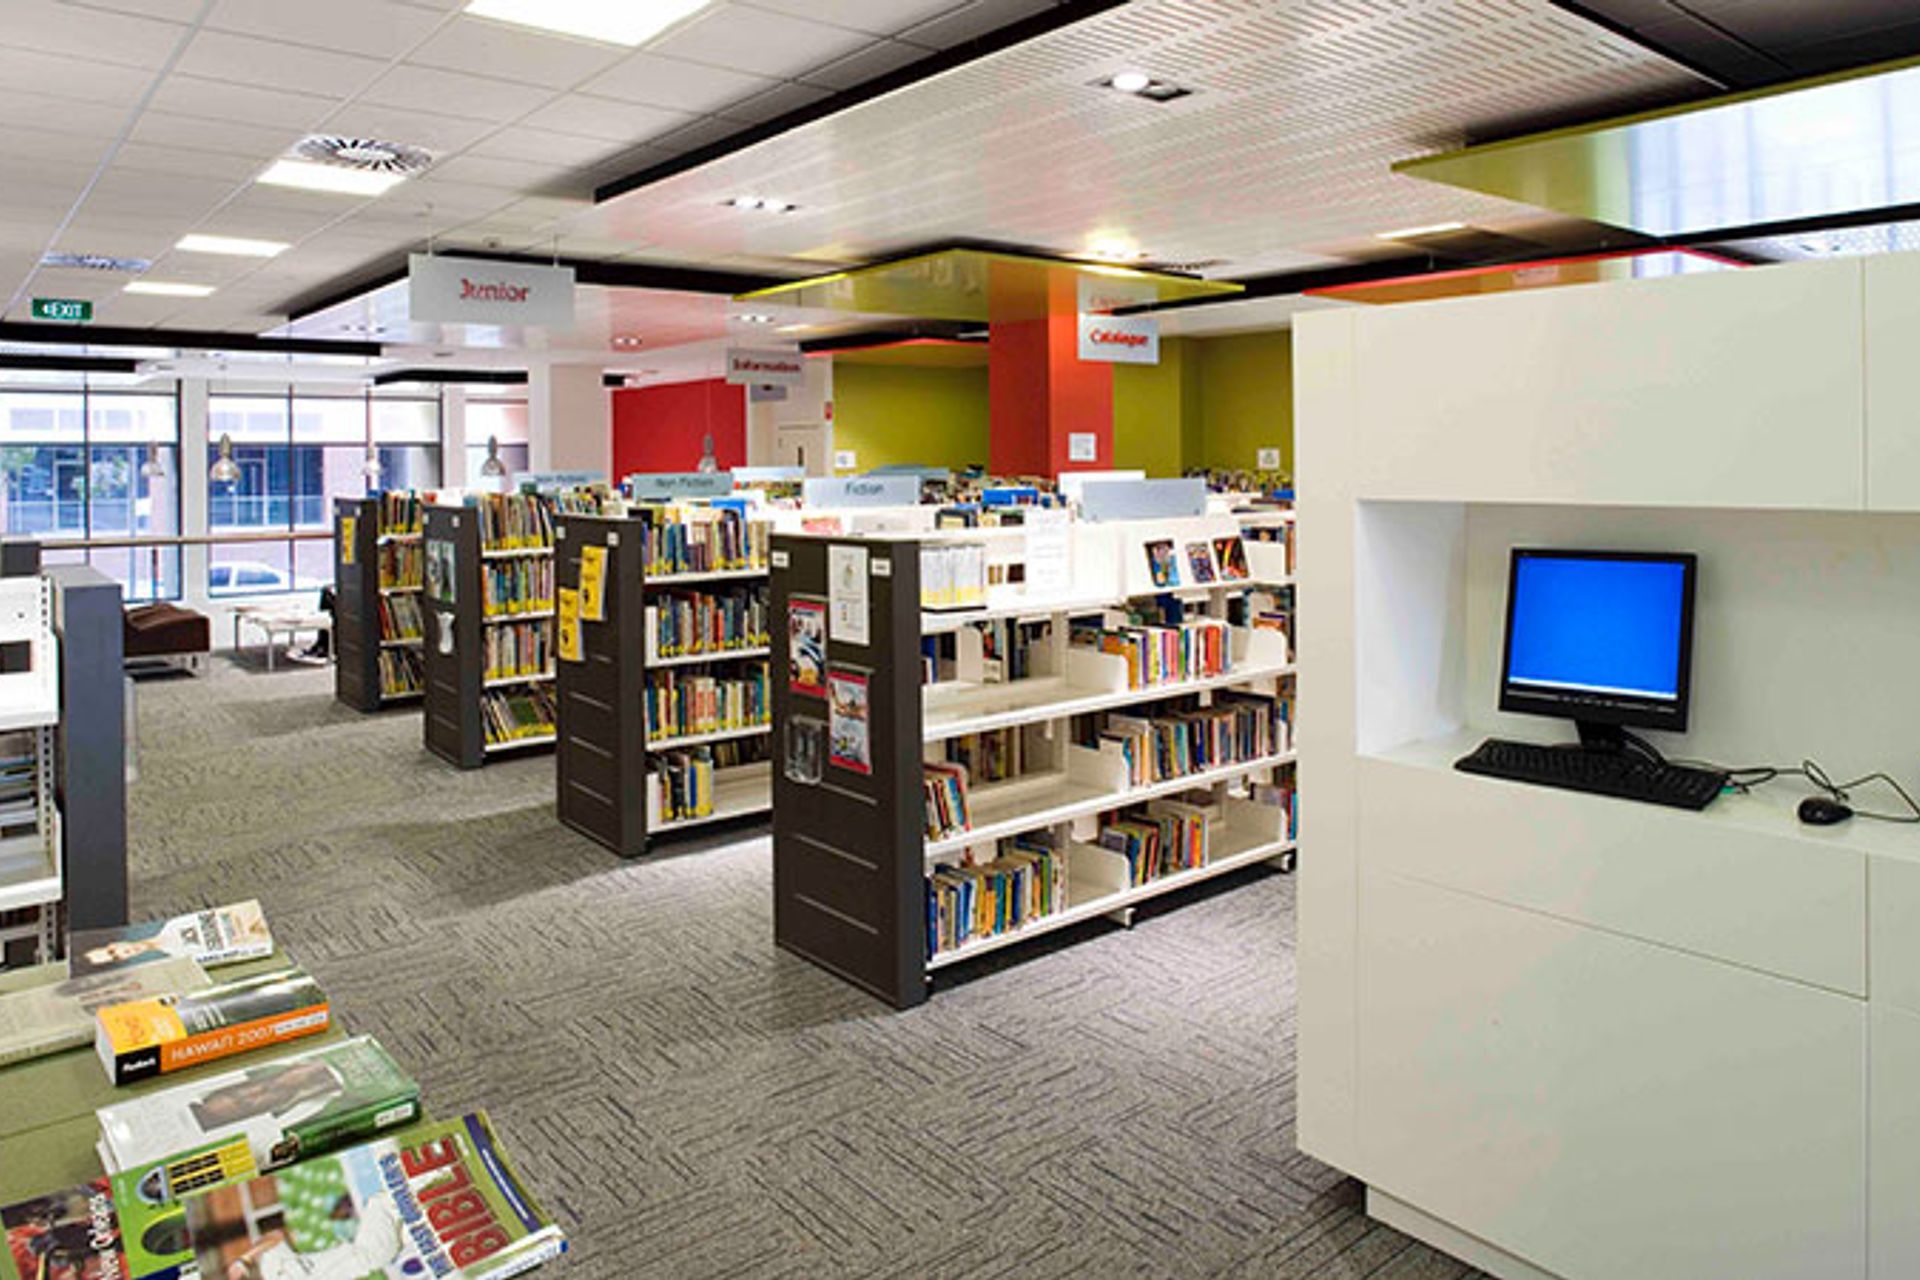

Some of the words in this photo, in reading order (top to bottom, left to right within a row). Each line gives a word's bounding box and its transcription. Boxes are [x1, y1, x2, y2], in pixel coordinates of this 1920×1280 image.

[460, 278, 529, 302] Junior
[51, 302, 83, 319] EXIT
[1089, 329, 1149, 348] Catalogue
[732, 358, 802, 373] Information
[680, 477, 715, 488] Fiction
[845, 480, 885, 496] Fiction
[237, 1026, 276, 1046] 2007
[400, 1136, 510, 1270] BIBLE
